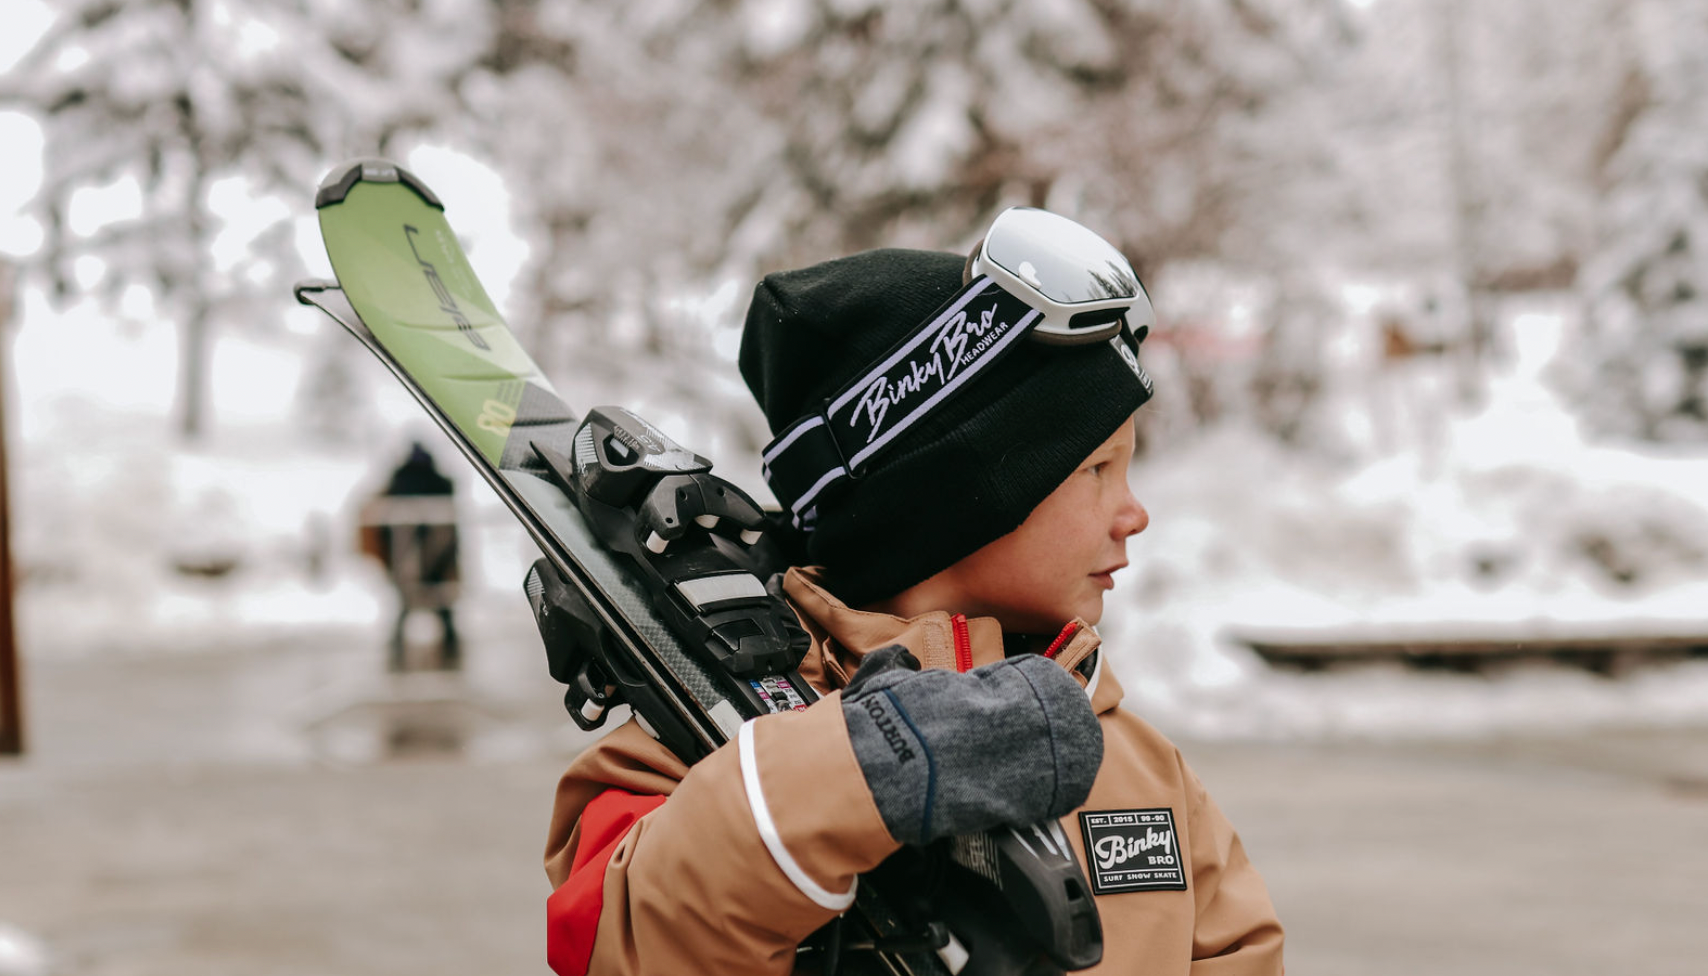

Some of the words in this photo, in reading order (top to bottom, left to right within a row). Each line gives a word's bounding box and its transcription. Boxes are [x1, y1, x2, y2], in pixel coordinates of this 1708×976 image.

[960, 321, 1009, 366] HEADWEAR
[861, 695, 916, 765] BURTON
[1094, 826, 1171, 870] Binky
[1147, 855, 1175, 865] BRO
[1103, 874, 1123, 882] SURF
[1126, 872, 1151, 880] SNOW
[1153, 871, 1177, 879] SKATE
